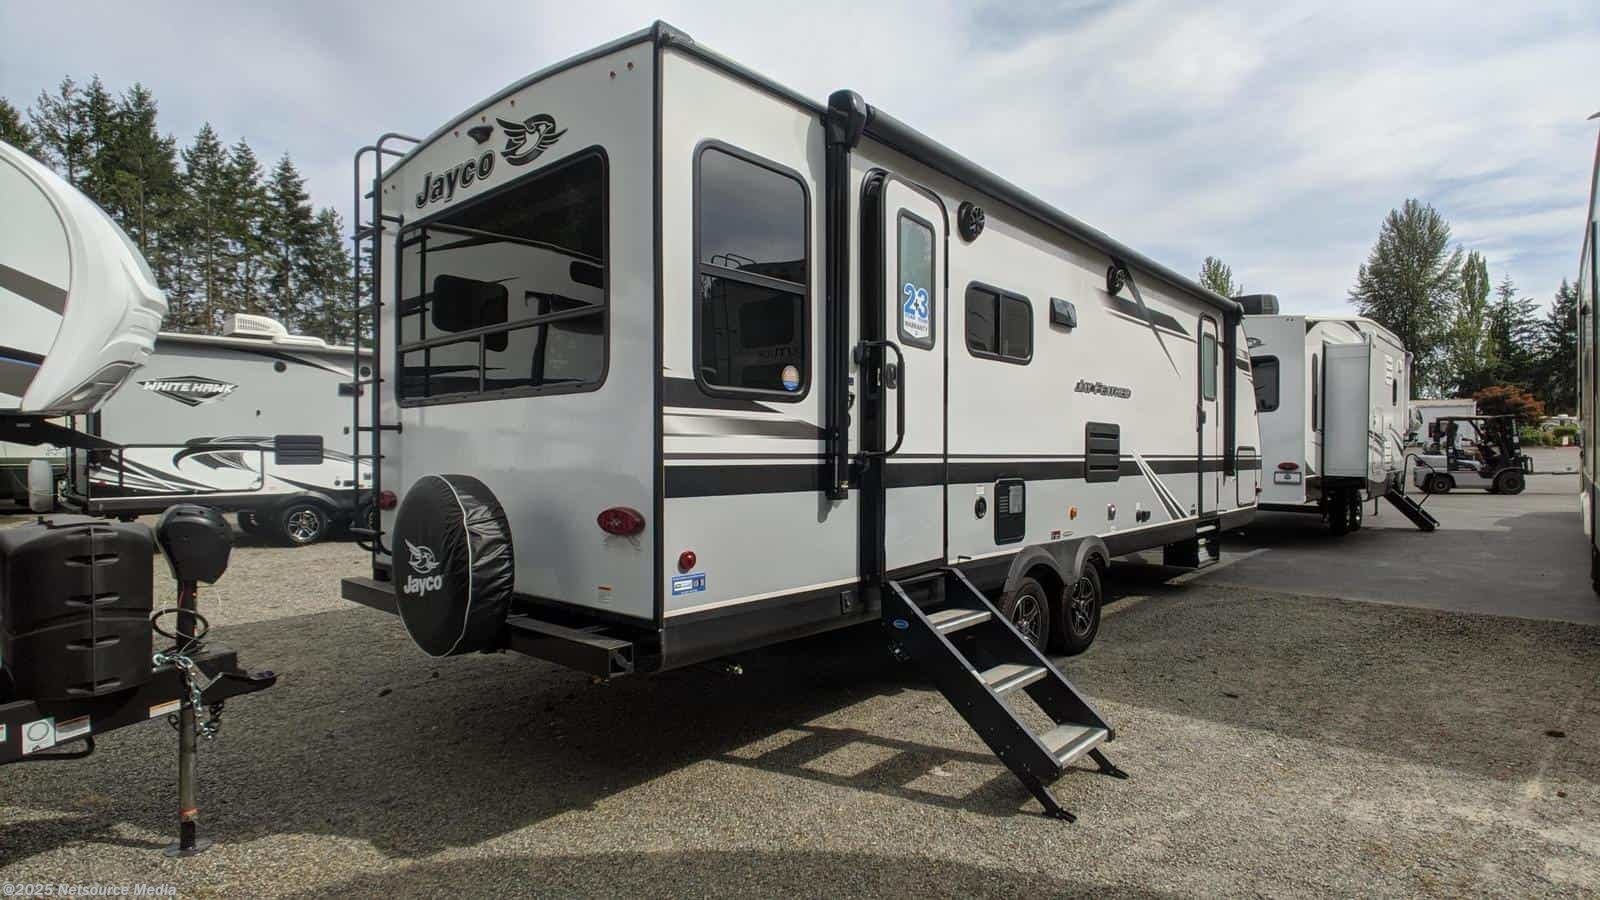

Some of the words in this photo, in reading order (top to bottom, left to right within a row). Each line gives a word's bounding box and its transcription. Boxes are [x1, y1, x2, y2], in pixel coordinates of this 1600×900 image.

[416, 150, 495, 209] Jayco
[143, 382, 191, 391] WHITE
[191, 383, 235, 393] HAWK
[403, 575, 443, 597] Jayco
